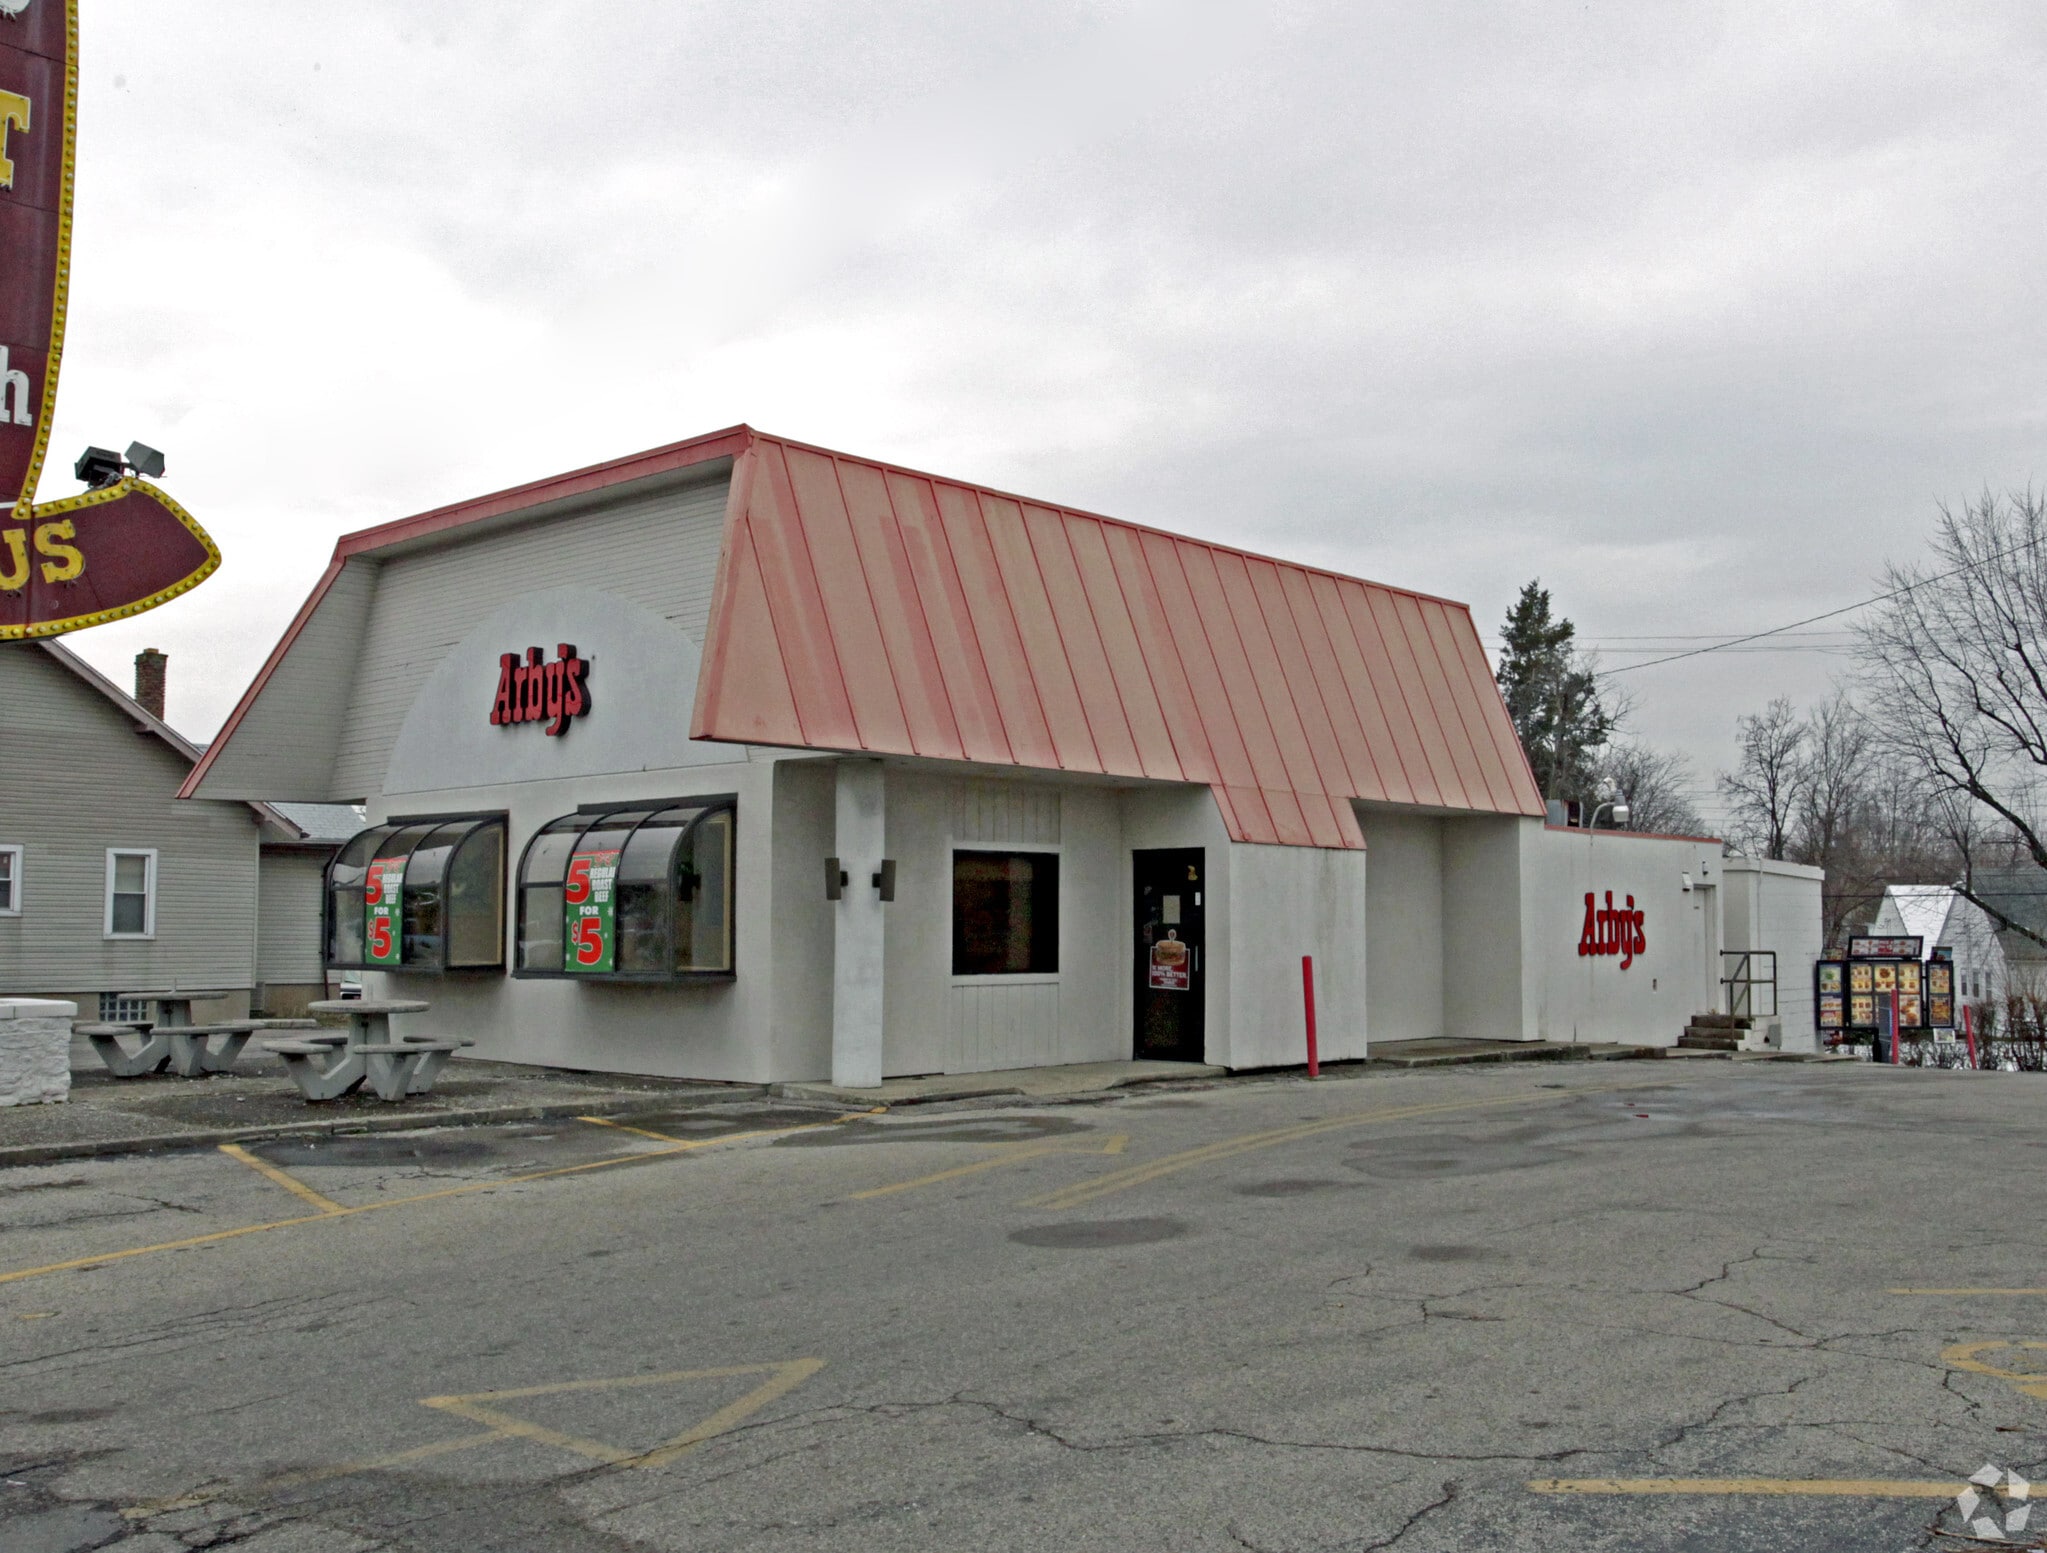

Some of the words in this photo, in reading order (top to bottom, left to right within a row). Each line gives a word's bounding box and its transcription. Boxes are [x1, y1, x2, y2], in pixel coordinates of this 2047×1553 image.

[490, 643, 592, 737] Arby's
[365, 865, 384, 905] 5
[566, 859, 591, 904] 5
[592, 879, 612, 890] ROAST
[594, 891, 609, 902] BEEF
[374, 907, 389, 915] FOR
[579, 906, 599, 915] FOR
[1578, 890, 1646, 970] Arby's
[368, 916, 392, 958] $5
[571, 917, 604, 965] $5
